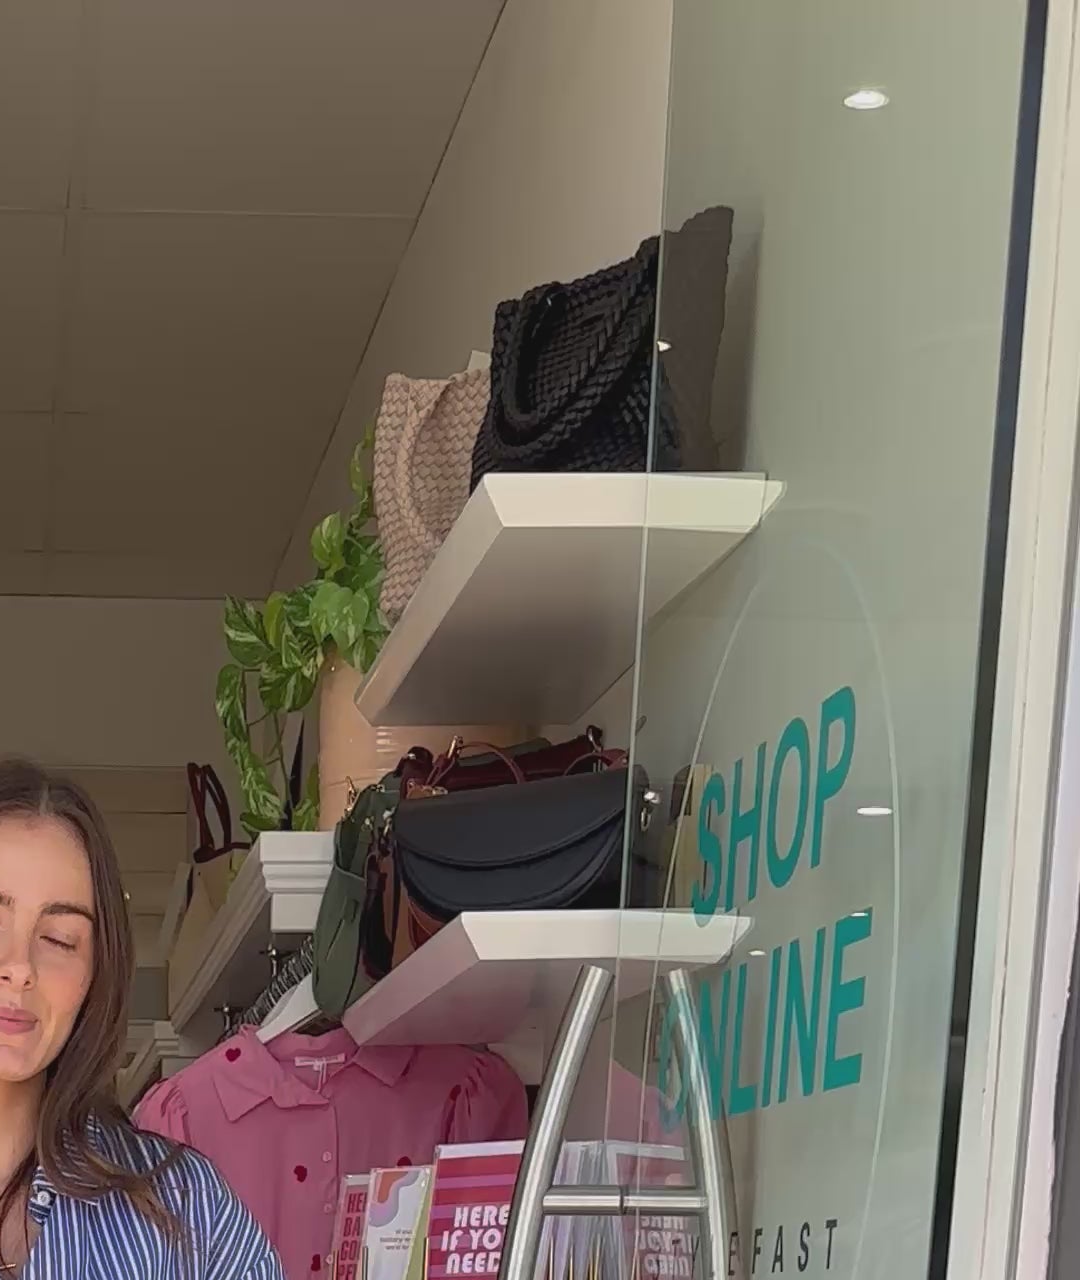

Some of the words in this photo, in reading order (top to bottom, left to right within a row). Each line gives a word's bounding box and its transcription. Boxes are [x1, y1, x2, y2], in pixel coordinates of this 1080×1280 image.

[691, 685, 857, 928] SHOP
[657, 906, 874, 1136] ONLINE
[453, 1204, 511, 1228] HERE
[441, 1229, 464, 1252] IF
[469, 1228, 506, 1251] YO
[446, 1251, 502, 1275] NEED
